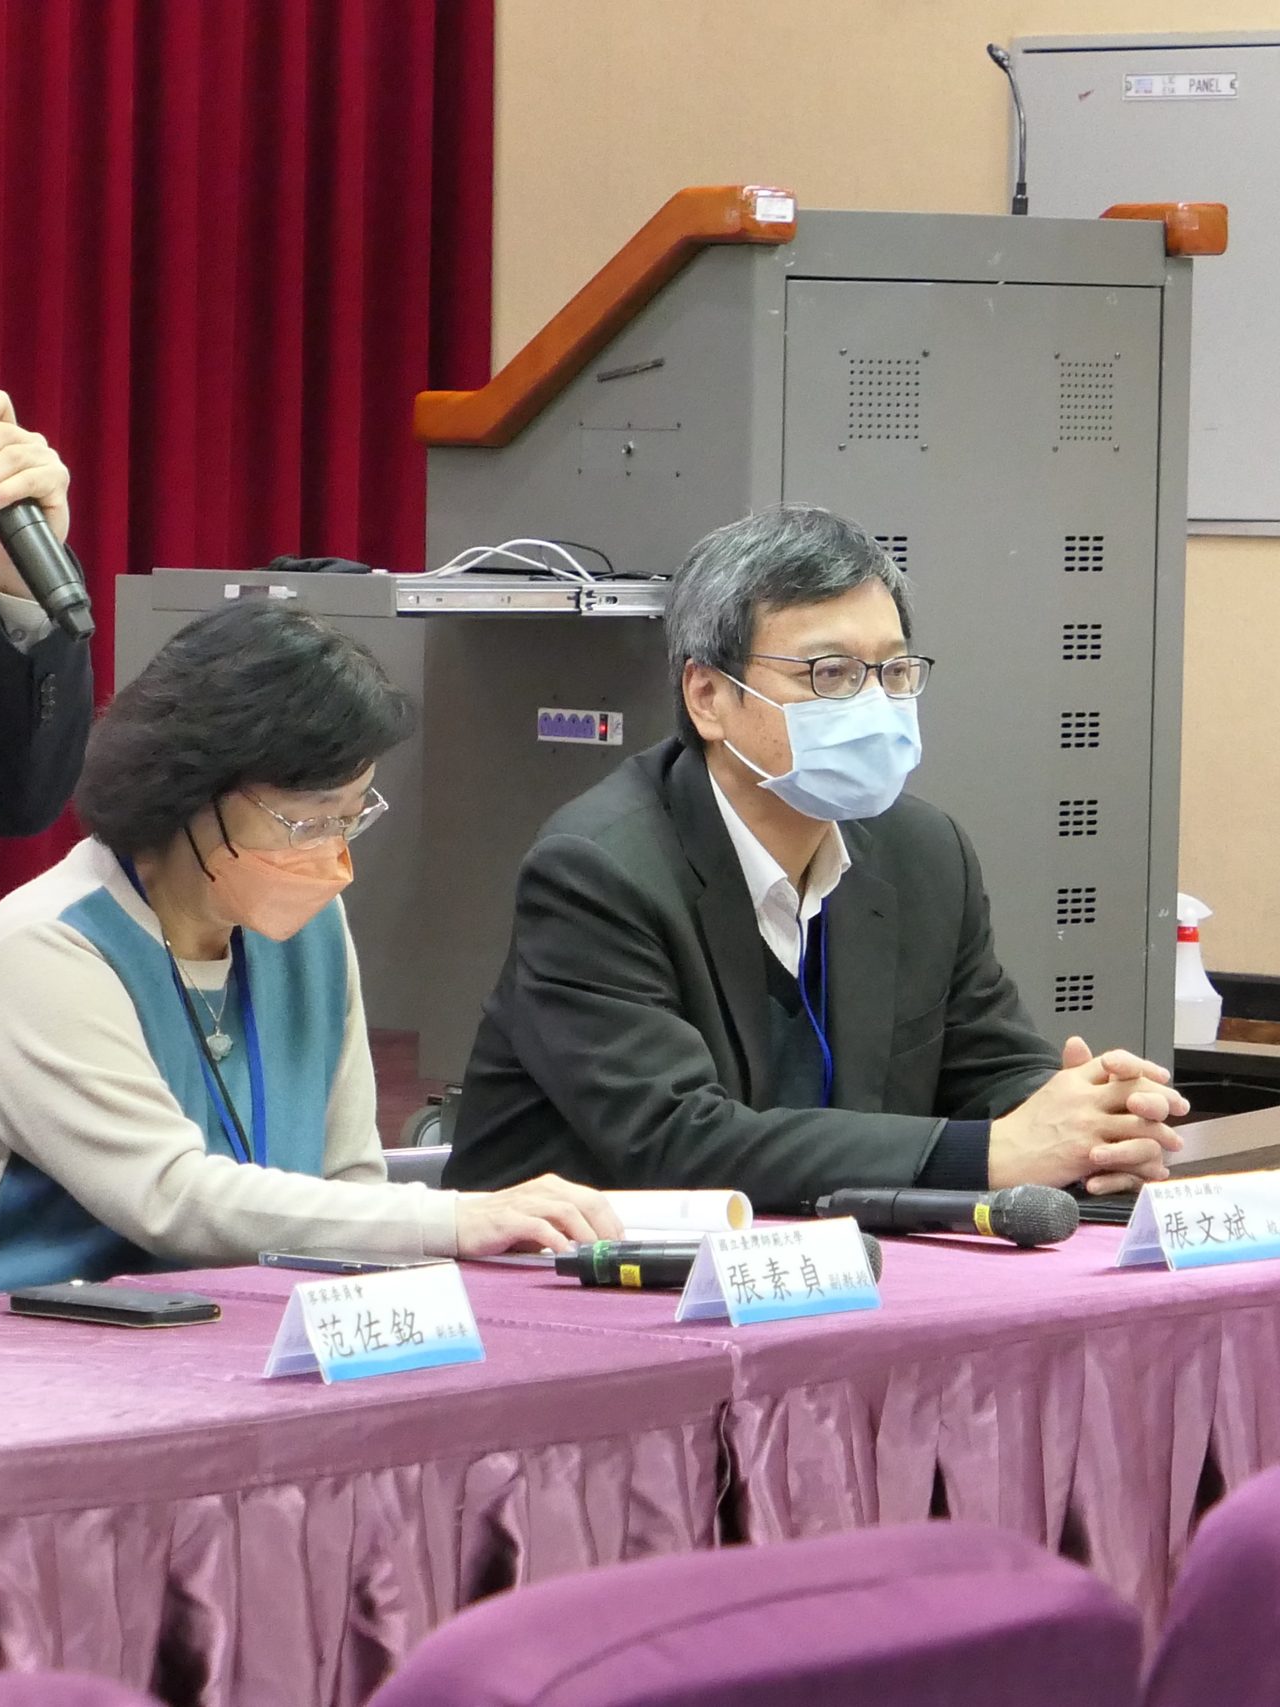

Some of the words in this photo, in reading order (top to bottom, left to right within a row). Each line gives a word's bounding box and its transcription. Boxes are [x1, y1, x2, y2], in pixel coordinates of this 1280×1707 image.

[1188, 78, 1222, 93] PANEL
[719, 1231, 803, 1251] 國立臺灣師範大學
[1164, 1205, 1257, 1249] 張文斌
[727, 1254, 825, 1305] 張素貞
[318, 1308, 424, 1358] 范佐銘
